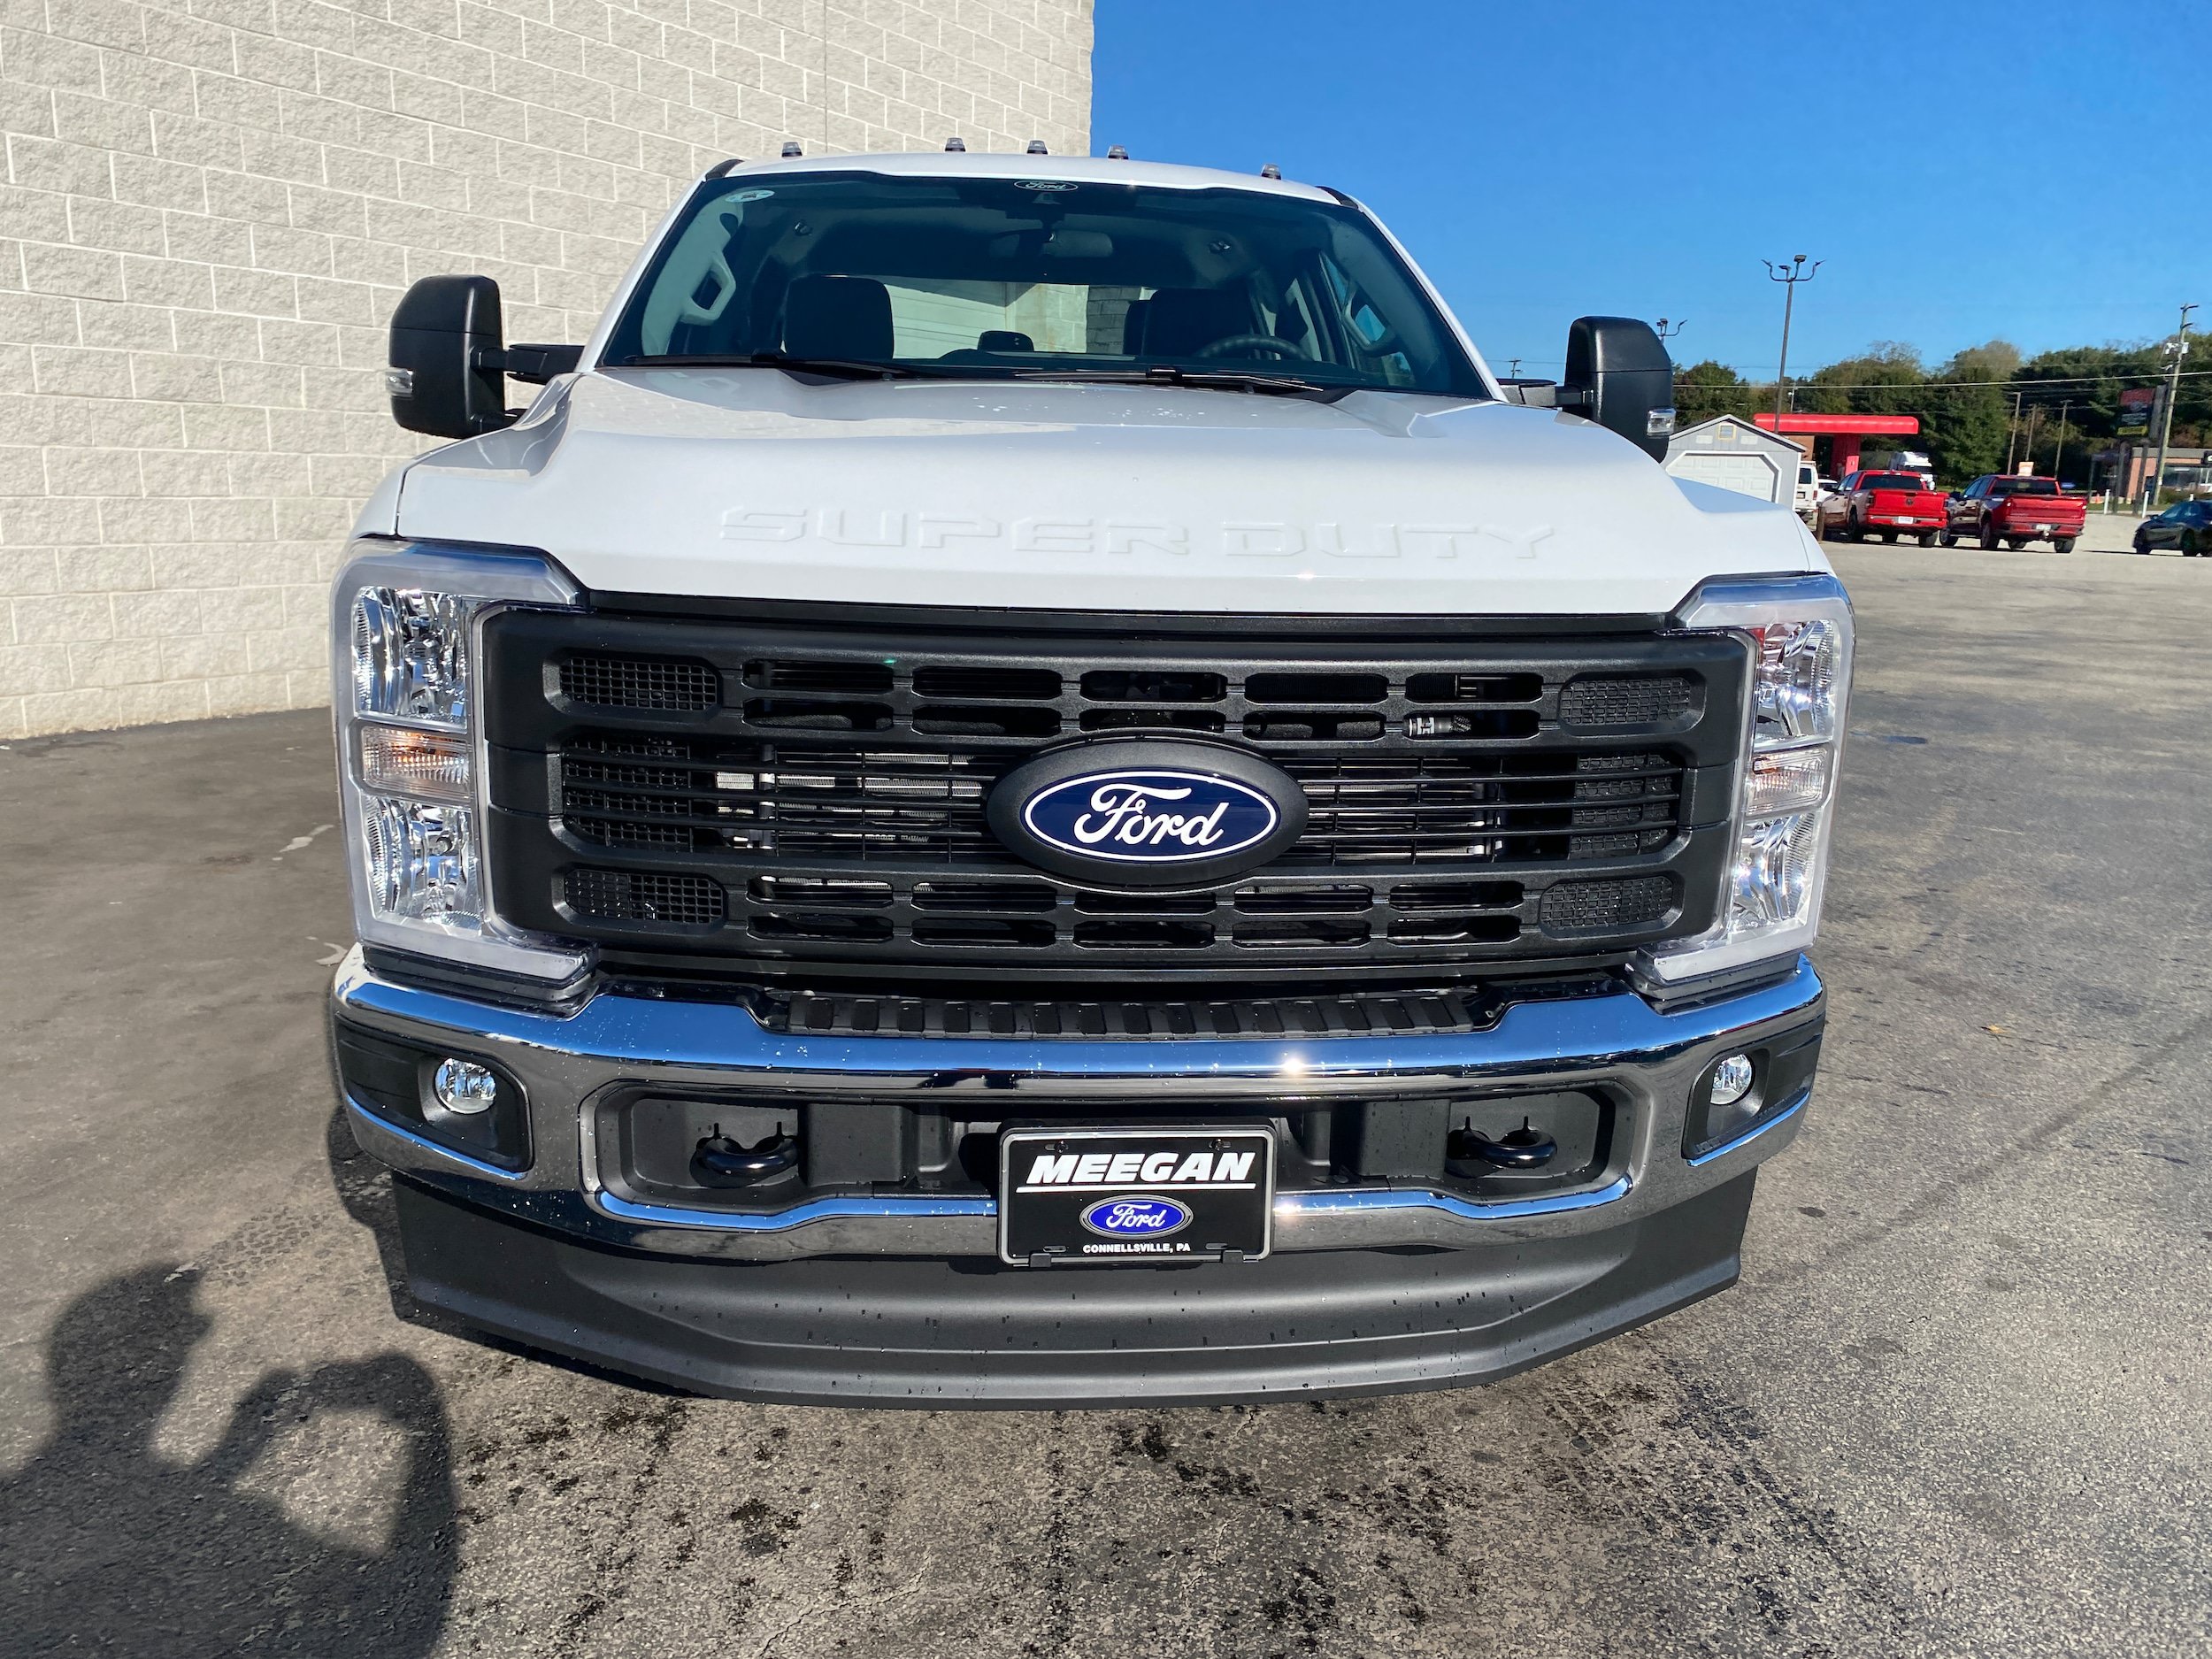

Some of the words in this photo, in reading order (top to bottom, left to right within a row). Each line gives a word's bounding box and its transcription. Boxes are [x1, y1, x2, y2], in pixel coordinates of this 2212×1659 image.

[719, 505, 1188, 556] SUPER
[1223, 522, 1555, 558] DUTY
[1073, 783, 1230, 845] Ford
[1025, 1152, 1256, 1184] MEEGAN
[1106, 1203, 1165, 1228] Ford
[1082, 1243, 1174, 1253] CONNELLSVILLE,
[1176, 1243, 1191, 1252] PA
